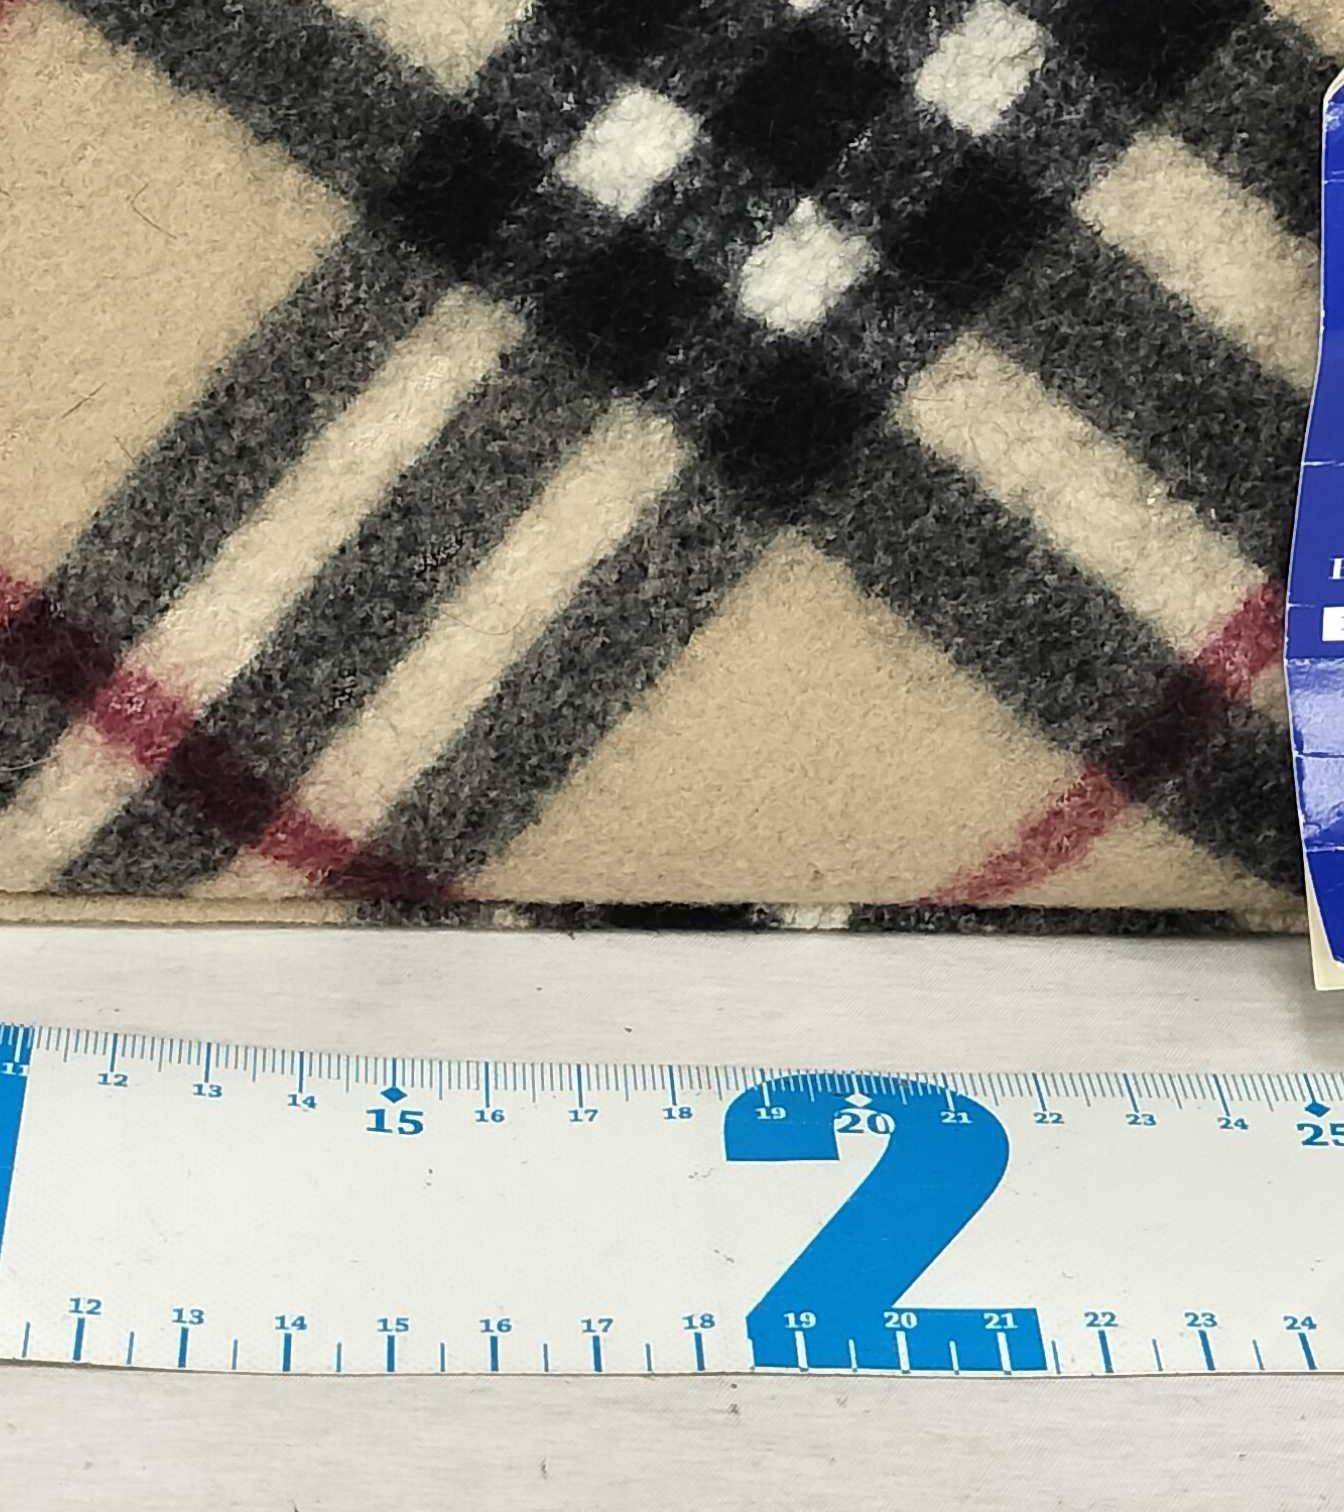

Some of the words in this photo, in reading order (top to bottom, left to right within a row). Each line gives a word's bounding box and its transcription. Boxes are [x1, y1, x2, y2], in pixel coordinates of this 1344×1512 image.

[1, 1062, 29, 1076] 11
[97, 1073, 129, 1087] 12
[192, 1084, 223, 1098] 13
[288, 1094, 317, 1109] 14
[365, 1108, 424, 1136] 15
[474, 1109, 505, 1123] 16
[568, 1109, 599, 1123] 17
[663, 1106, 693, 1120] 18
[756, 1107, 787, 1121] 19
[835, 1108, 896, 1134] 20
[940, 1111, 972, 1124] 21
[1034, 1111, 1065, 1124] 22
[1126, 1114, 1156, 1127] 23
[1217, 1117, 1249, 1130] 24
[724, 1073, 1046, 1370] 2
[68, 1297, 102, 1316] 12
[172, 1308, 205, 1326] 13
[274, 1315, 308, 1331] 14
[376, 1317, 410, 1333] 15
[479, 1318, 513, 1333] 16
[581, 1318, 613, 1333] 17
[682, 1314, 716, 1330] 18
[784, 1313, 816, 1329] 19
[883, 1313, 917, 1329] 20
[984, 1313, 1018, 1329] 21
[1084, 1312, 1118, 1327] 22
[1184, 1312, 1218, 1328] 23
[1283, 1316, 1317, 1330] 24
